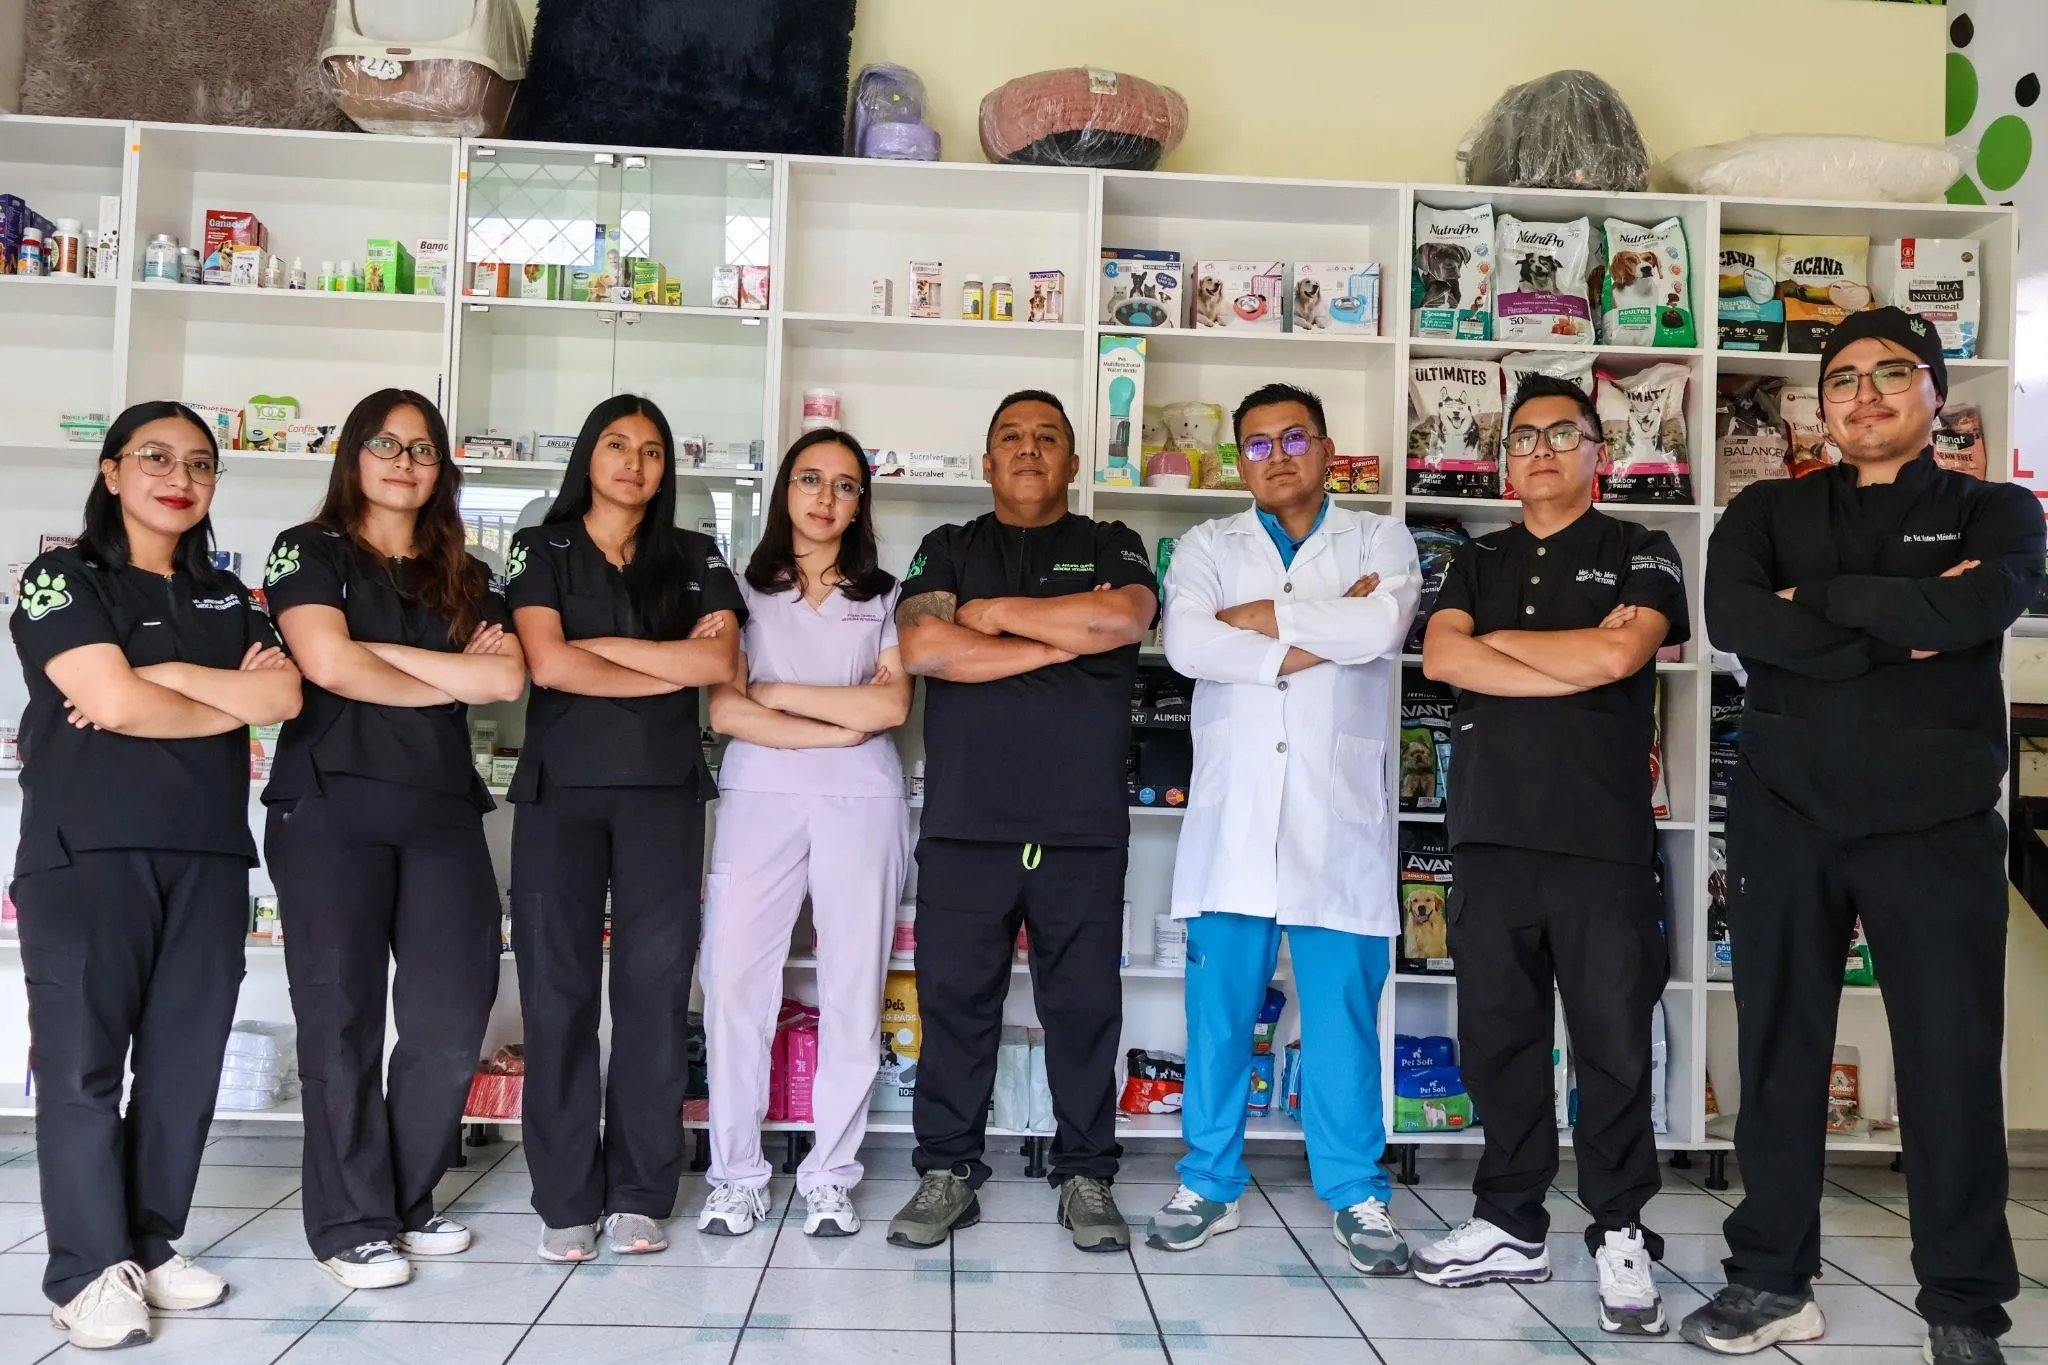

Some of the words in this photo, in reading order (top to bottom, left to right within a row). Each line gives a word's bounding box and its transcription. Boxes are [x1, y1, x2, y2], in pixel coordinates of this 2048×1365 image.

[1430, 223, 1478, 235] NutraPro
[1516, 230, 1564, 247] NutraPro
[1719, 250, 1755, 268] CANA
[1793, 257, 1844, 275] ACANA
[1912, 291, 1961, 300] NATURAL
[1936, 434, 1966, 444] ownat
[910, 453, 943, 461] Sucralvet
[1957, 453, 1973, 461] FREE
[910, 470, 944, 478] Sucralvet
[1631, 563, 1656, 571] HOSPITAL
[1401, 704, 1454, 718] AVANT
[1153, 714, 1191, 722] ALIMENT
[1407, 855, 1453, 871] AVAN
[885, 998, 905, 1011] Pets
[894, 1014, 916, 1022] PADS
[1416, 1058, 1433, 1066] Soft
[899, 1088, 909, 1096] 10
